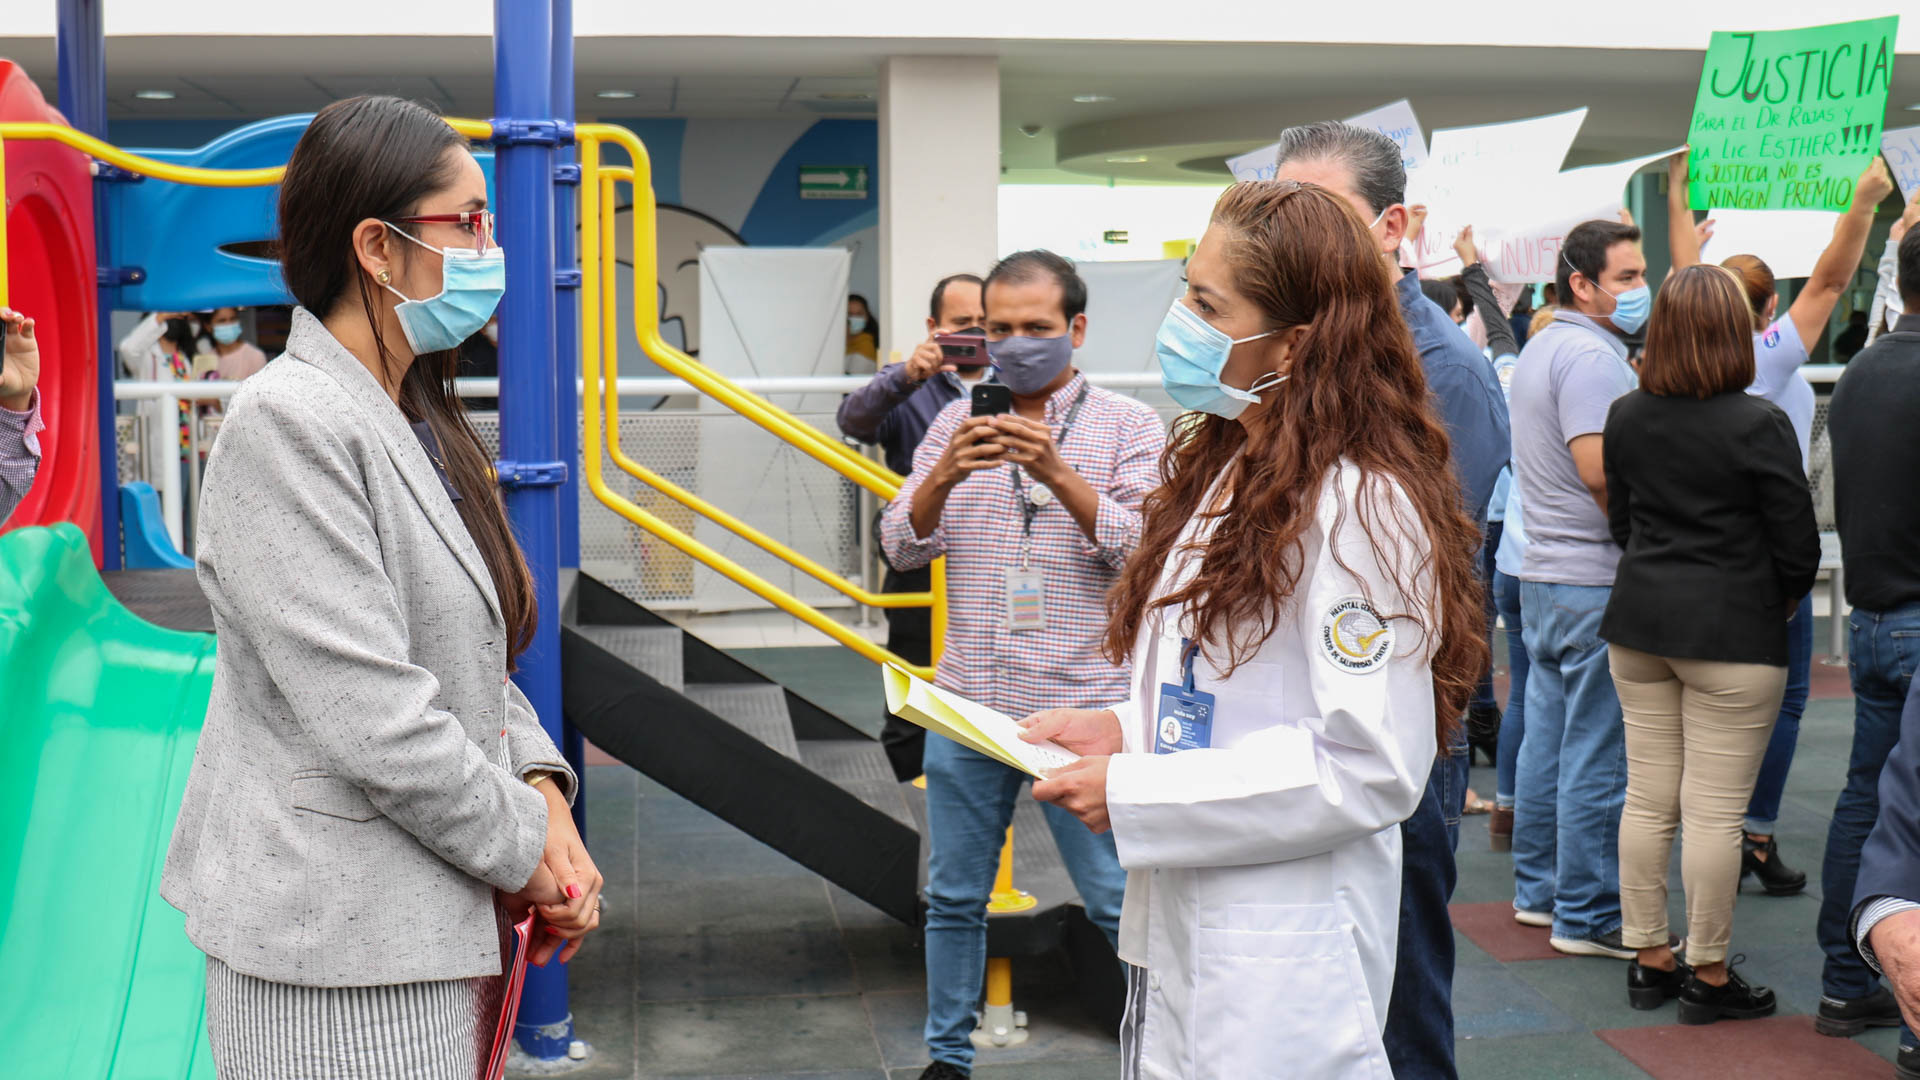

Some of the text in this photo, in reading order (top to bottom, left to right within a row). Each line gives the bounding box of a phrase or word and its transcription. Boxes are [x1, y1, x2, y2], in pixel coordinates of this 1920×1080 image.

[1711, 33, 1888, 104] JUSTICIA
[1694, 111, 1726, 132] PARA
[1731, 115, 1746, 131] EL
[1845, 105, 1854, 125] Y
[1722, 137, 1747, 159] LIC
[1760, 132, 1836, 159] ESTHER
[1705, 163, 1767, 184] JUSTICIA
[1778, 161, 1798, 180] NO
[1805, 164, 1822, 179] ES
[1782, 176, 1852, 209] PREMIO
[1330, 601, 1359, 618] HOSPITAL
